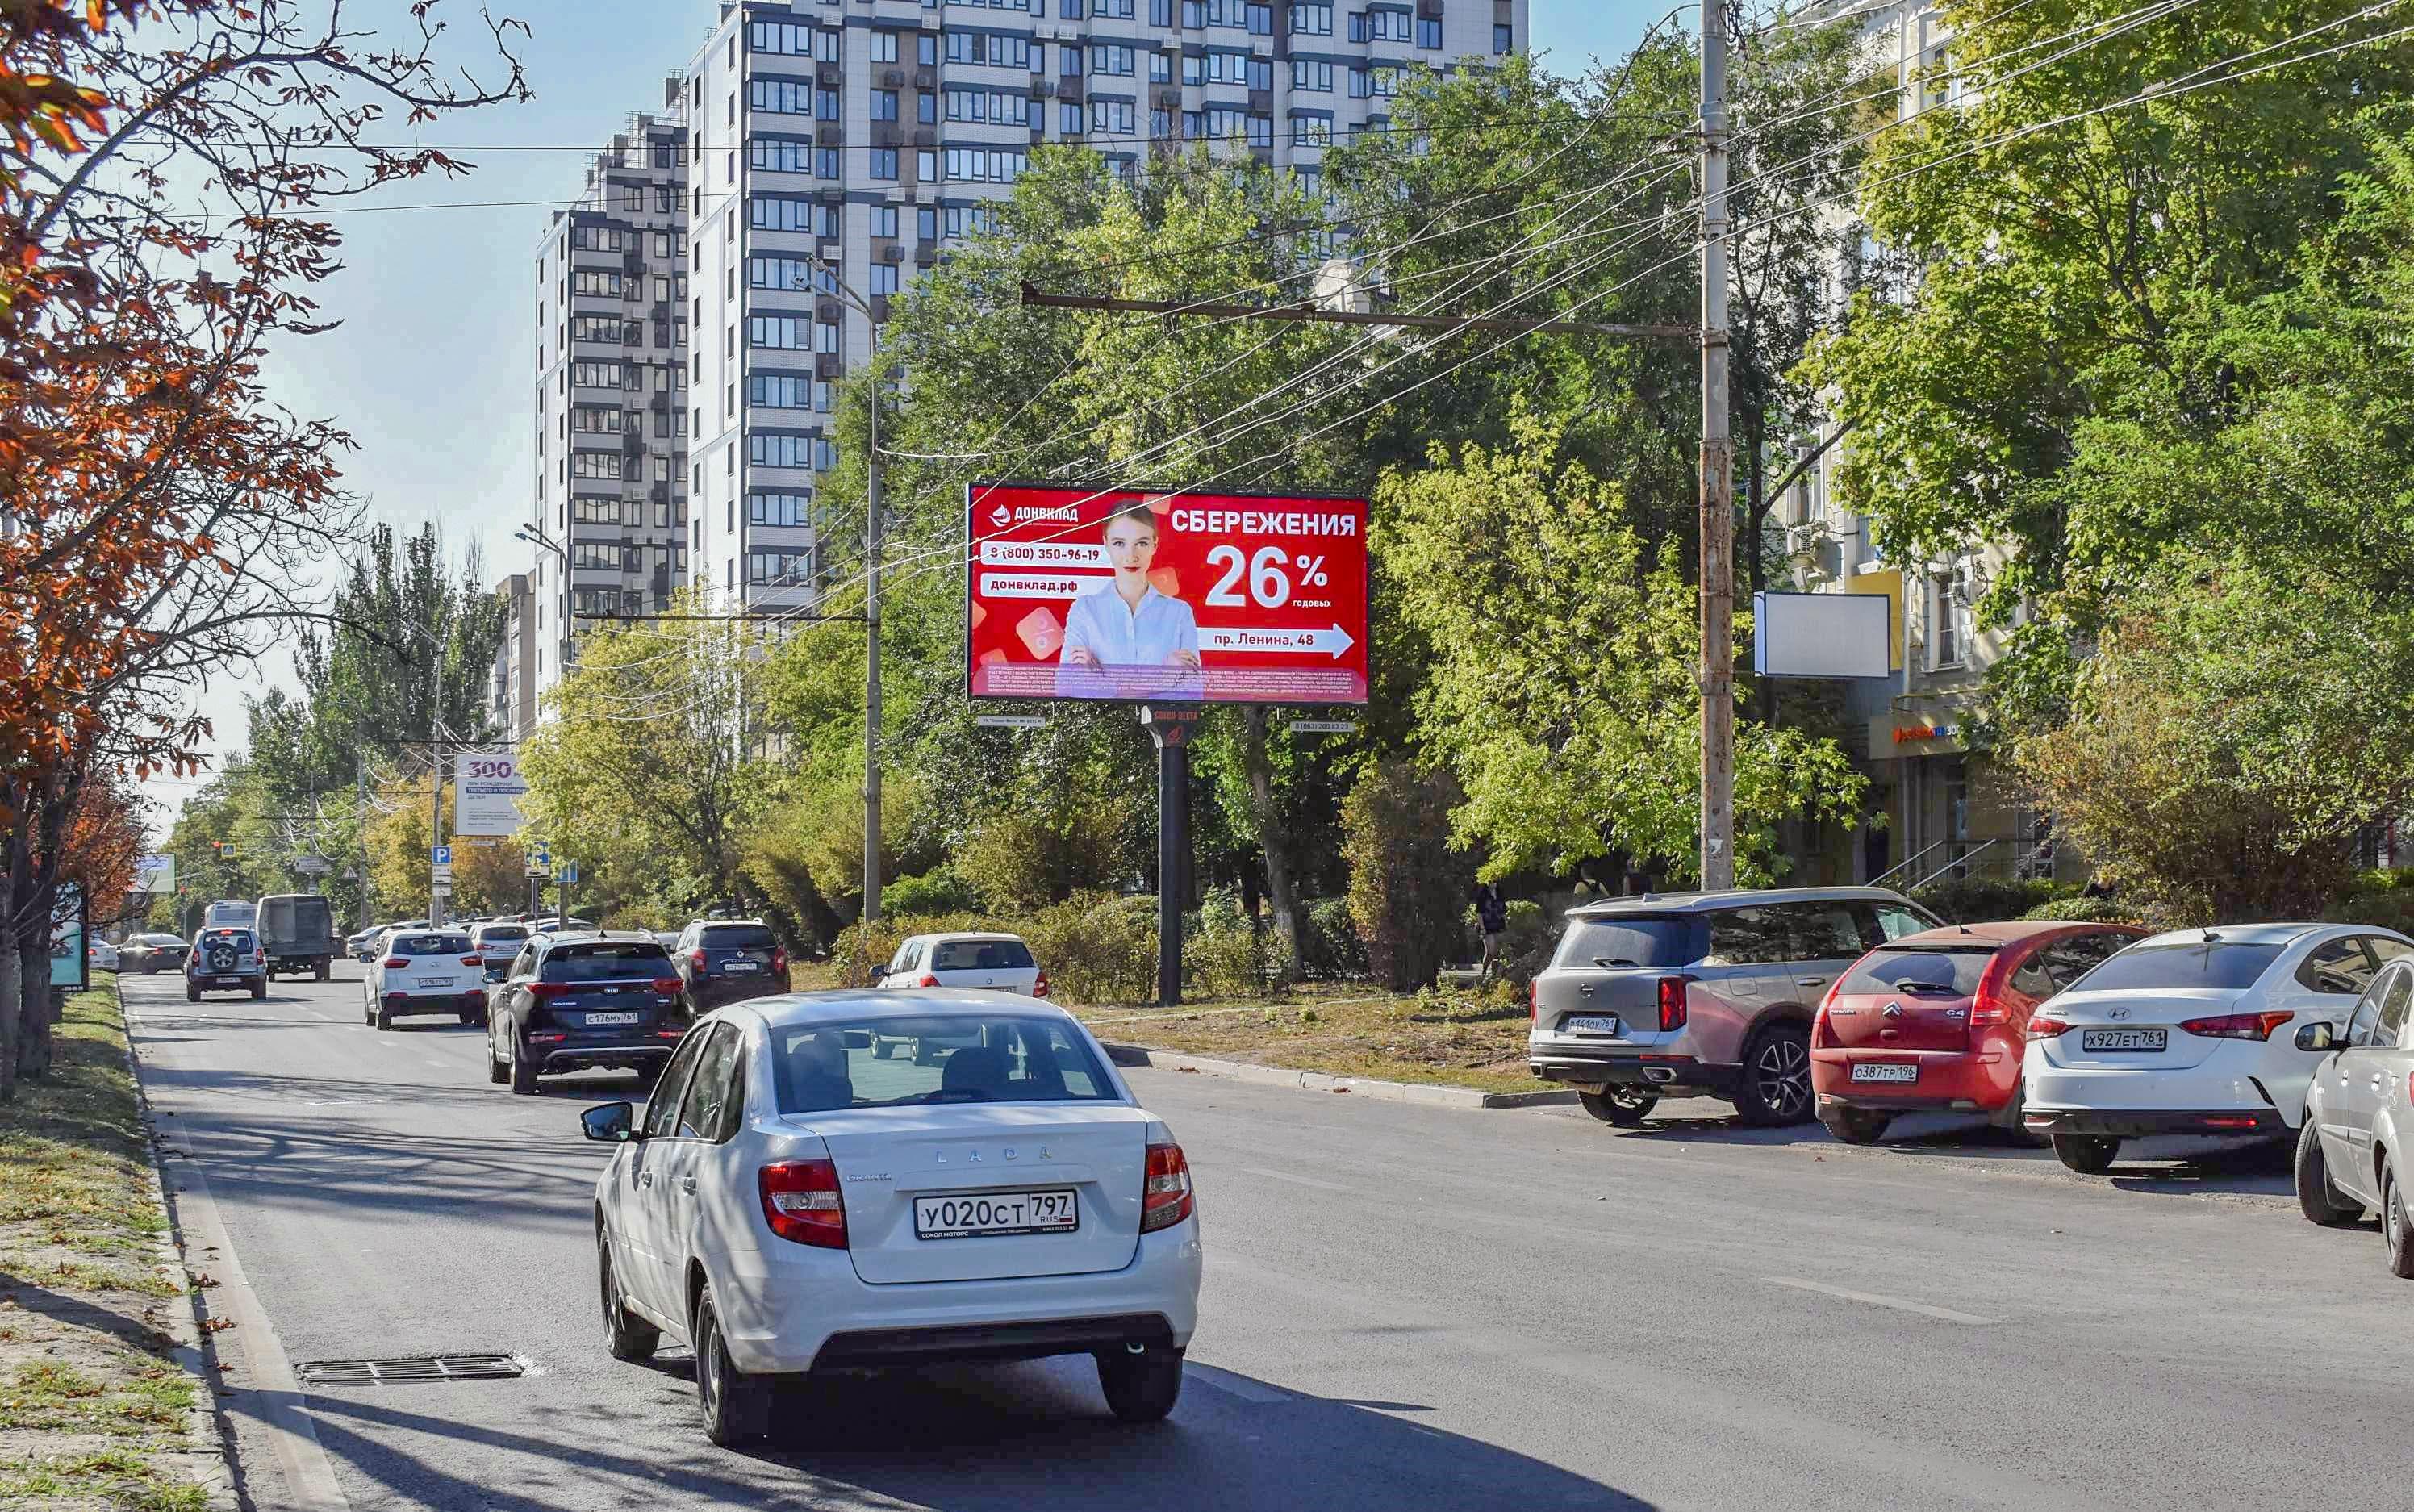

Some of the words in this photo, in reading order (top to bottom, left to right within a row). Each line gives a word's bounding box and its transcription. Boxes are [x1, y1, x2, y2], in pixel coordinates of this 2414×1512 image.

[1014, 507, 1078, 522] ДОНВКЛАД
[1172, 510, 1355, 536] СБЕРЕЖЕНИЯ
[1003, 547, 1034, 560] (800)
[1038, 548, 1099, 561] 350-96-19
[1205, 545, 1291, 608] 26
[1297, 555, 1328, 587] %
[991, 580, 1078, 593] донвклад.рф
[1293, 599, 1331, 608] годовых
[1214, 634, 1234, 646] пр.
[1238, 633, 1293, 647] Ленина,
[1297, 634, 1314, 645] 48
[468, 761, 512, 779] 300
[437, 849, 447, 862] P
[587, 1013, 621, 1023] С176МУ
[1945, 1009, 1965, 1017] C4
[1602, 1018, 1614, 1028] 761
[2088, 1032, 2140, 1047] Х927ЕТ
[2142, 1031, 2163, 1042] 761
[1856, 1065, 1895, 1079] О387ТР
[1898, 1066, 1913, 1076] 196
[936, 1147, 1052, 1163] LADA
[925, 1200, 1025, 1228] У020СТ
[1031, 1195, 1068, 1216] 797
[1040, 1215, 1059, 1223] RUS
[921, 1231, 943, 1239] СОКОЛ
[943, 1230, 968, 1238] МОТОРС
